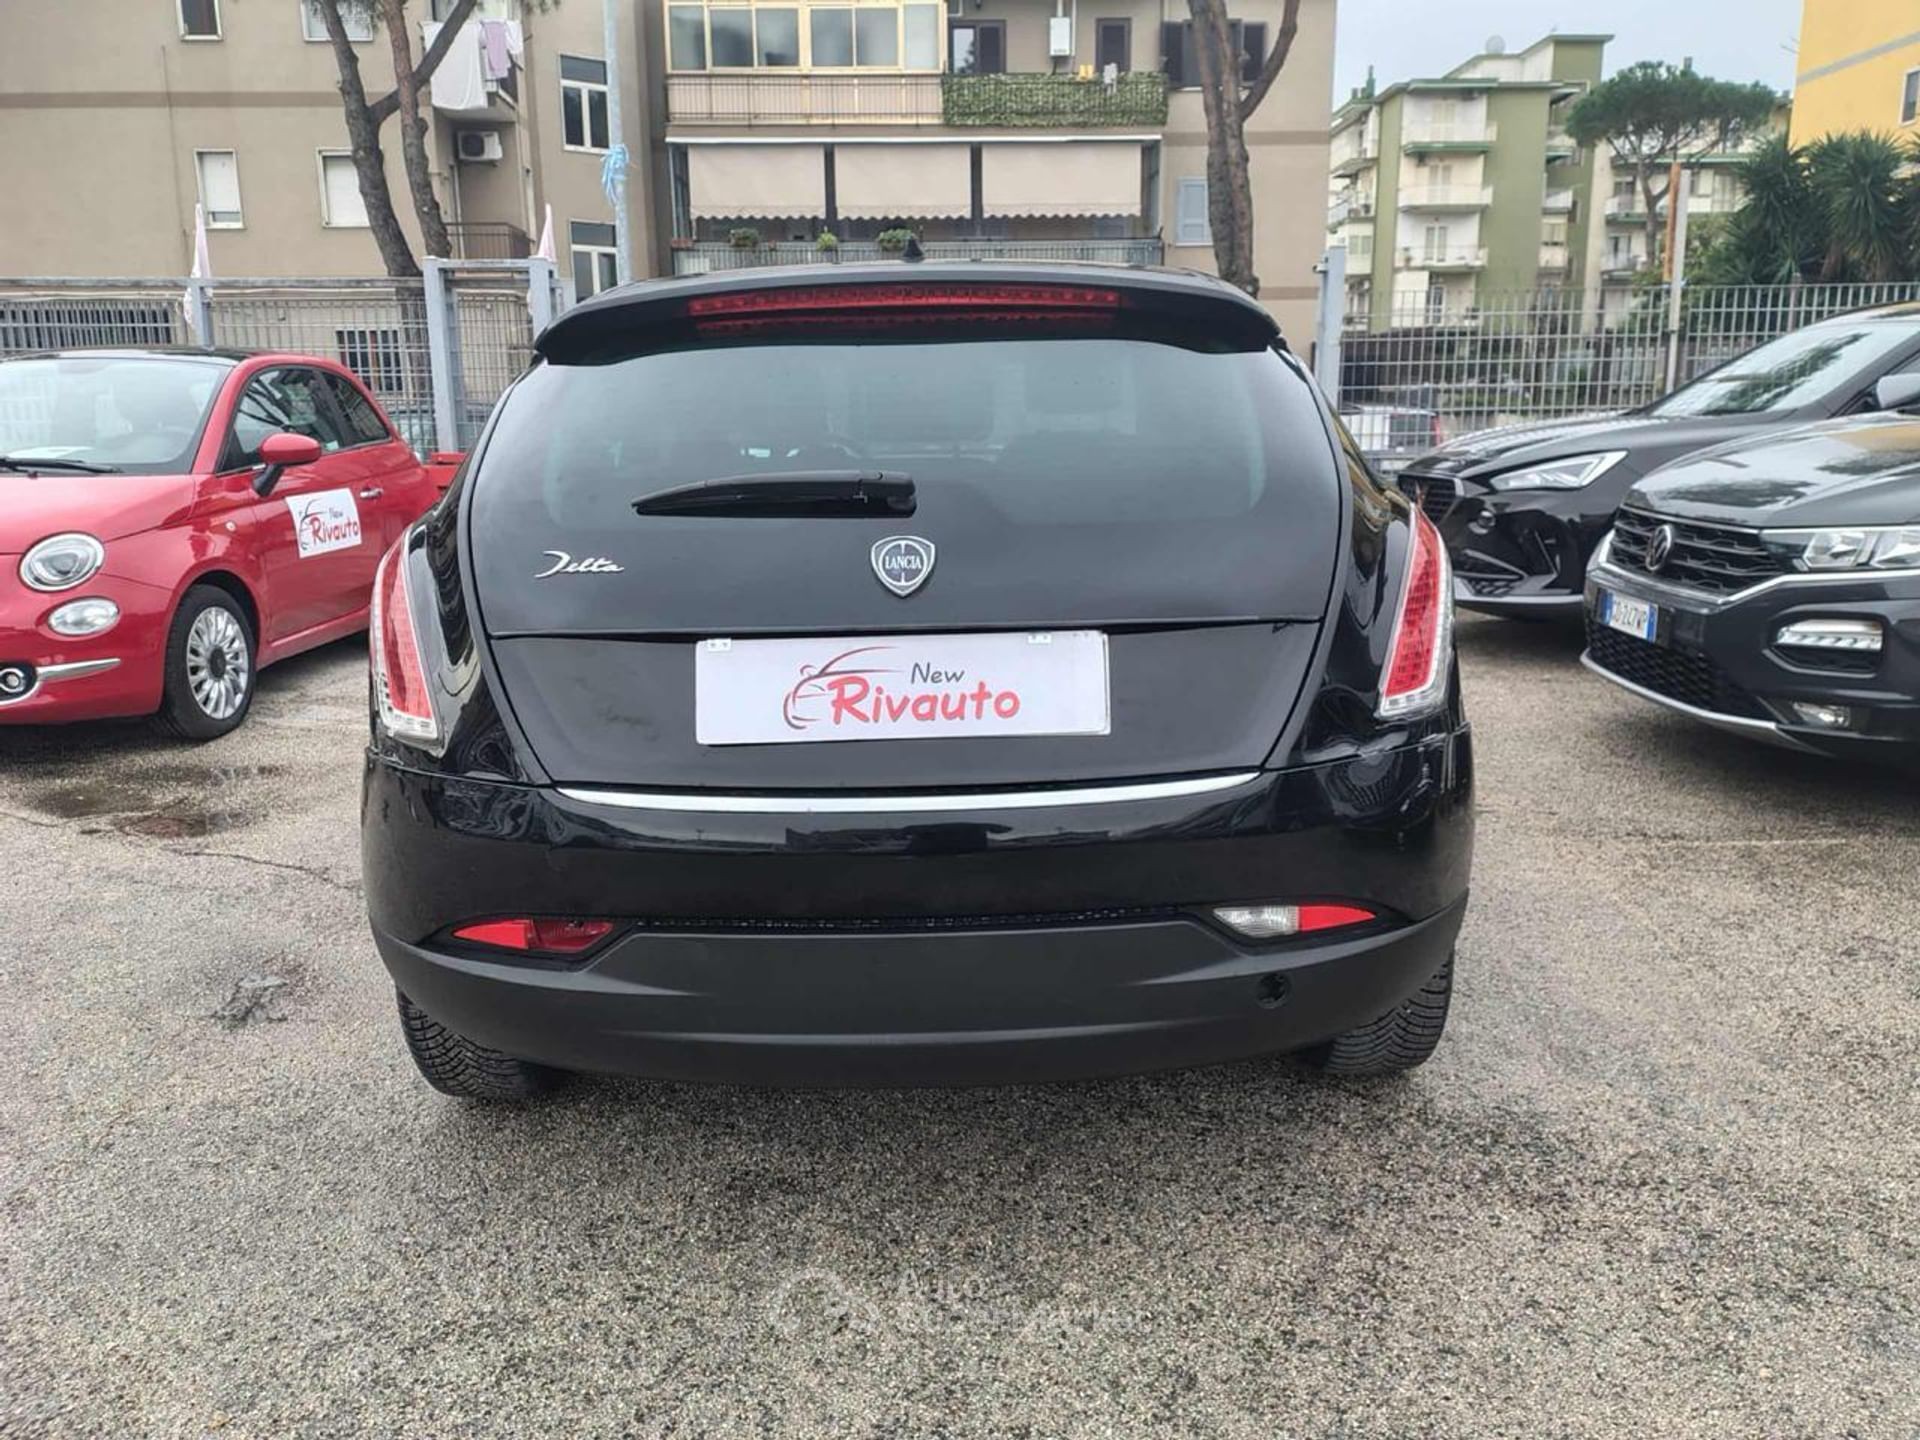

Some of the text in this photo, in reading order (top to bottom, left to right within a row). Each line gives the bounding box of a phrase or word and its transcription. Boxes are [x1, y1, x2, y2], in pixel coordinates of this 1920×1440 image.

[309, 516, 359, 546] Rivauto
[534, 550, 625, 579] Delta
[885, 555, 922, 569] LANCIA
[910, 661, 966, 685] New
[827, 674, 1021, 726] Rivauto
